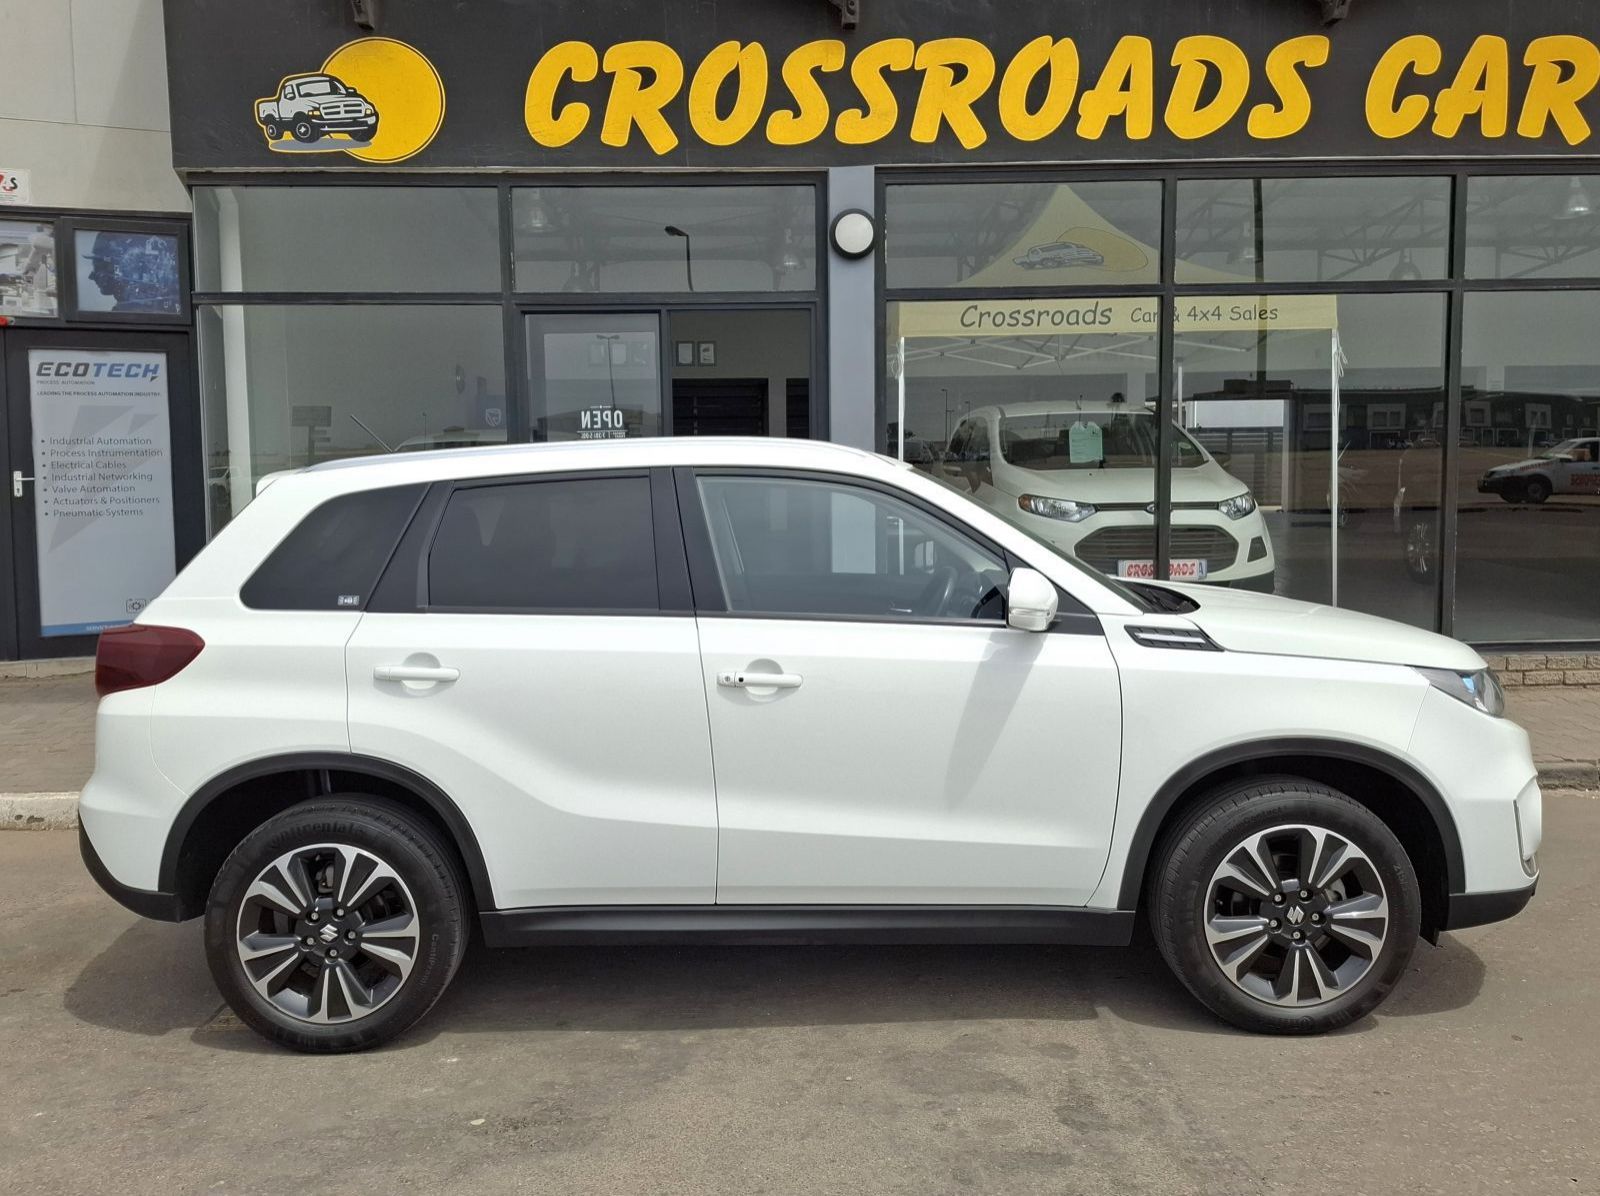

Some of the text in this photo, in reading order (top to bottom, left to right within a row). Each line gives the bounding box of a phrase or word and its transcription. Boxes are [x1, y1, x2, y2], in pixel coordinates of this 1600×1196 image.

[524, 35, 1330, 155] CROSSROADS
[960, 301, 1113, 328] Crossroads
[1187, 305, 1222, 321] 4x4
[1229, 304, 1279, 321] Sales
[36, 362, 160, 380] ECOTECH
[49, 437, 152, 446] Industrial Automation
[50, 448, 163, 457] Process Instrumentation
[51, 461, 127, 470] Electrical Cables
[51, 472, 153, 482] Industrial Networking
[52, 485, 136, 494] Valve Automation
[53, 496, 161, 506] Actuators & Positioners
[53, 508, 143, 518] Pneumatic Systems
